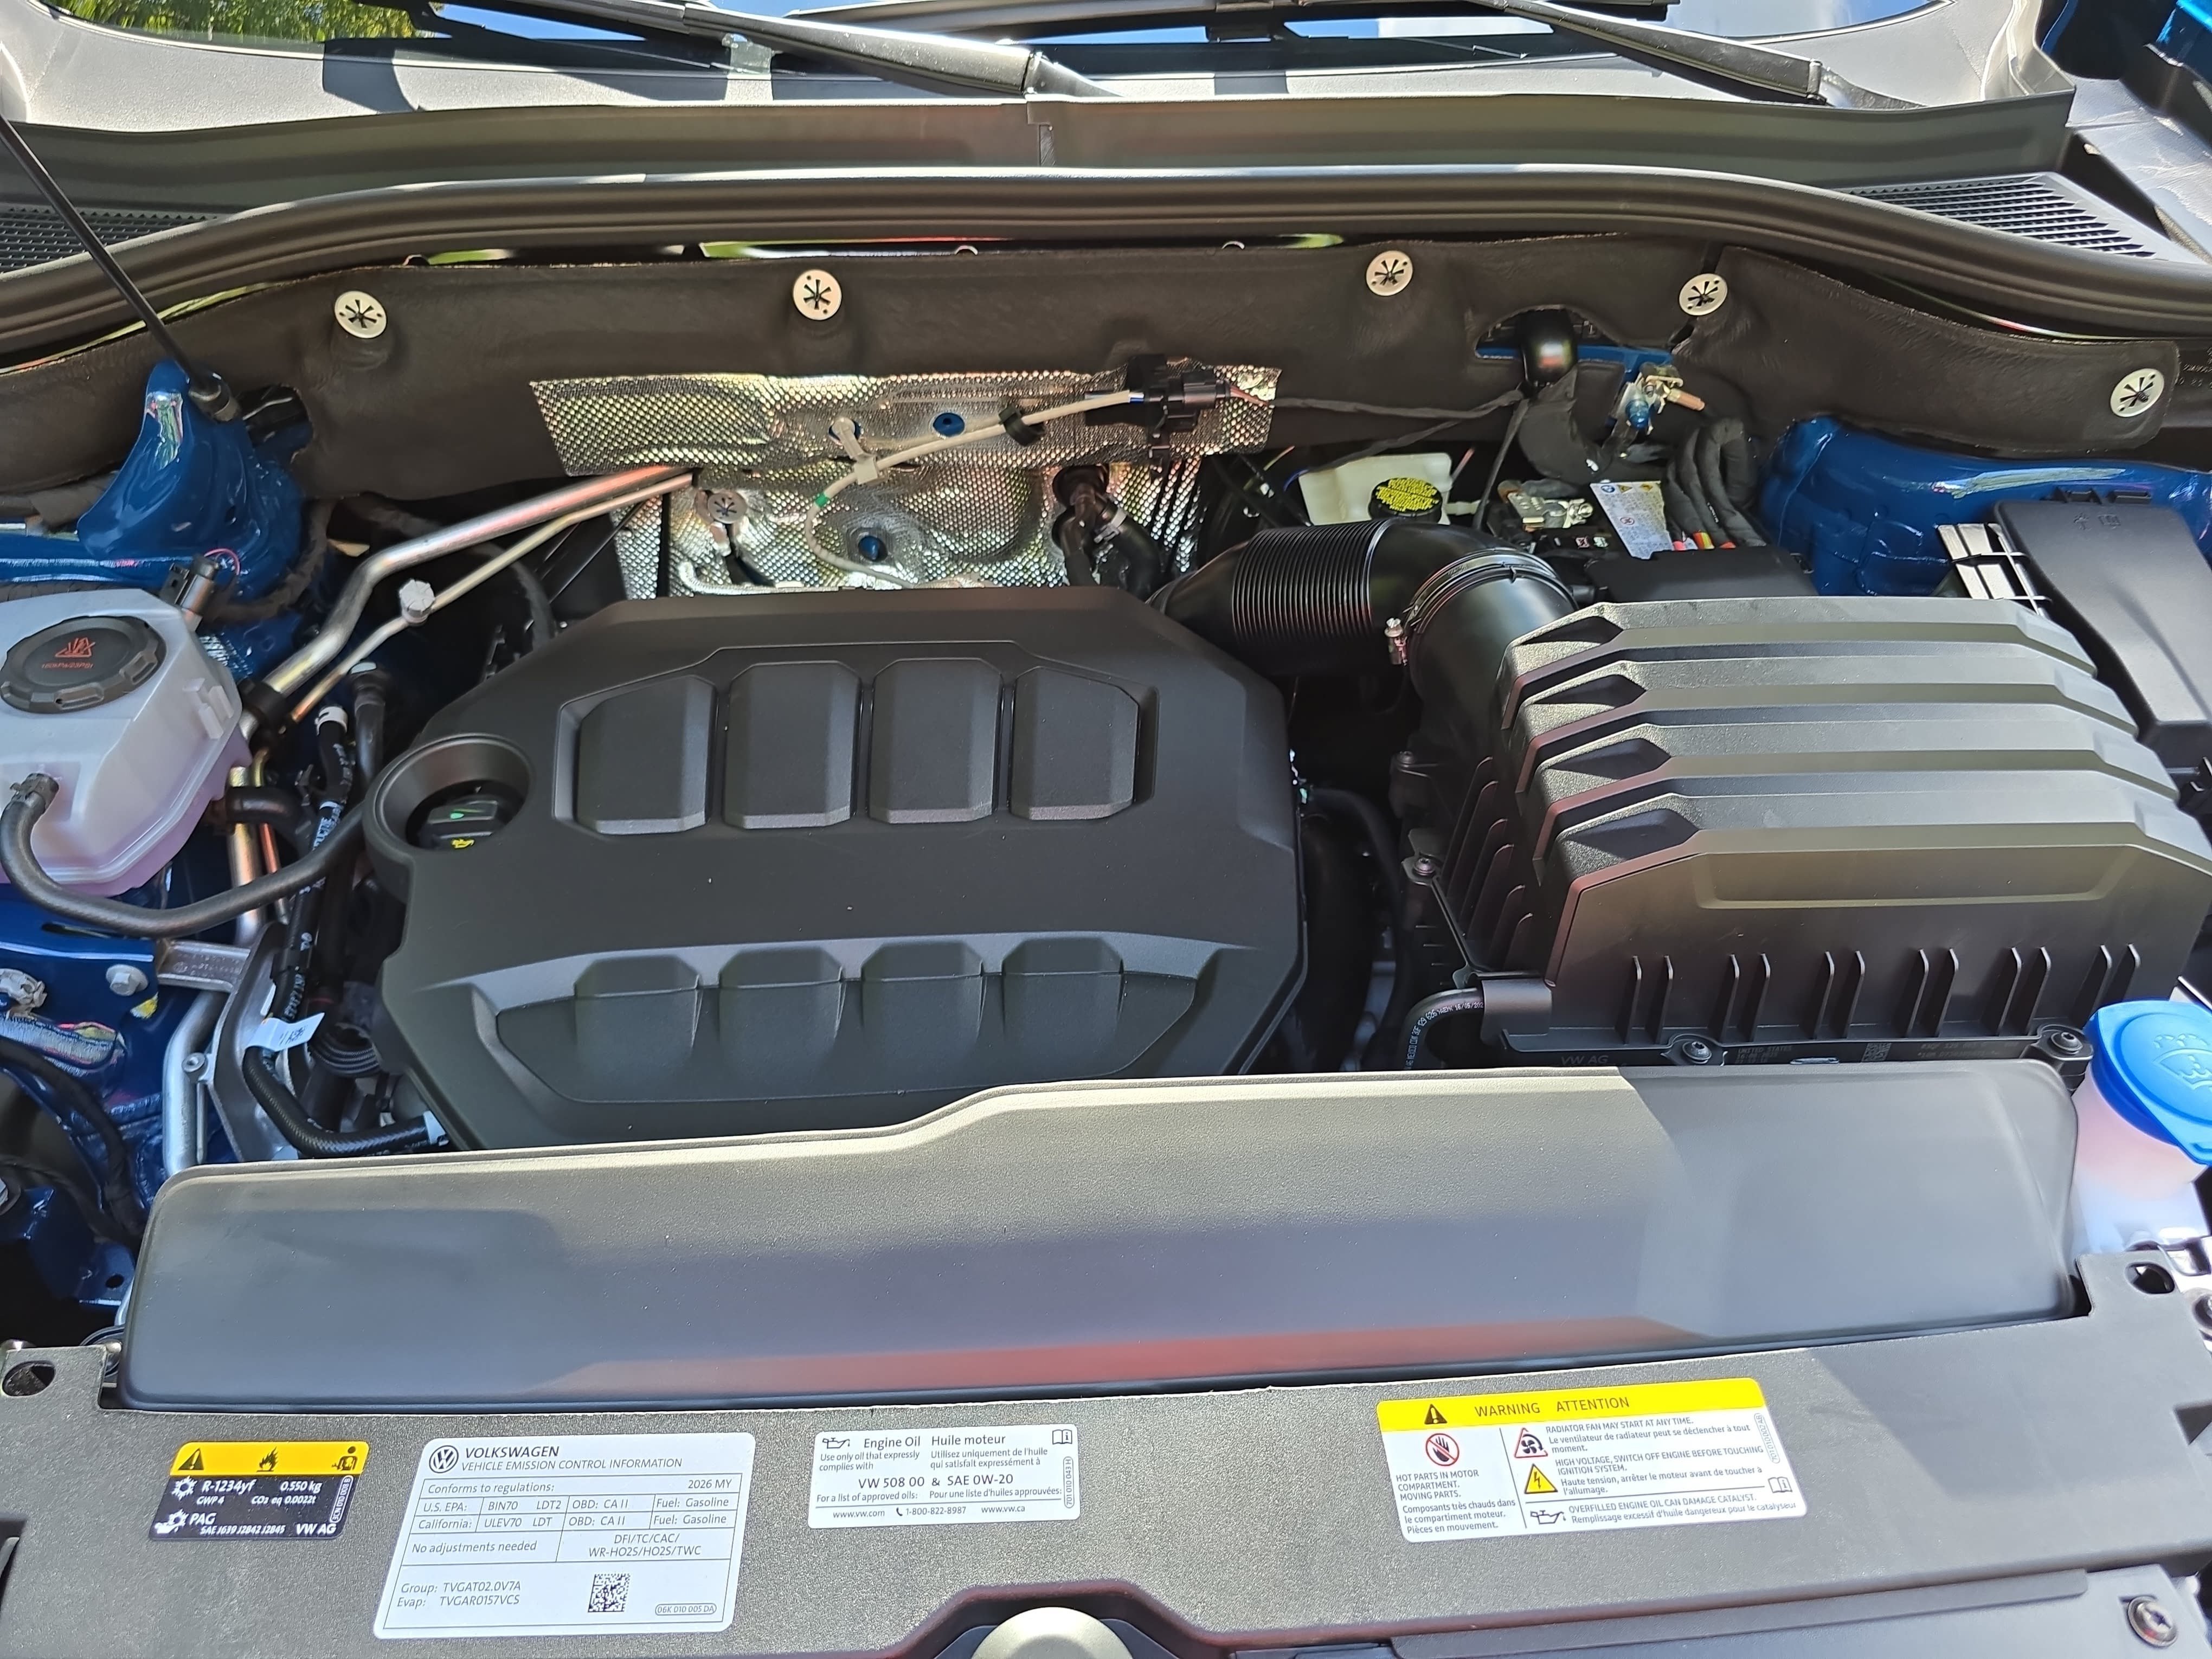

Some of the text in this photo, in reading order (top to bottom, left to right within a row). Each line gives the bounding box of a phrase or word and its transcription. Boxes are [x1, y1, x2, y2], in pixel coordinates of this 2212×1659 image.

[1561, 1055, 1609, 1065] VW AG
[1475, 1397, 1630, 1417] WARNING ATTENTION
[1546, 1424, 1584, 1433] RADIATOR
[1586, 1423, 1601, 1431] FAN
[1621, 1420, 1643, 1428] START
[931, 1435, 1006, 1446] Huile moteur
[1560, 1433, 1602, 1443] ventilateur
[1616, 1429, 1651, 1439] radiateur
[1654, 1428, 1671, 1438] peut
[1683, 1426, 1725, 1435] déclencher
[864, 1436, 921, 1450] Engine Oil
[465, 1446, 560, 1458] VOLKSWAGEN
[931, 1450, 960, 1458] Utilisez
[962, 1449, 1009, 1459] uniquement
[1552, 1445, 1587, 1454] moment.
[837, 1452, 853, 1462] only
[855, 1452, 864, 1460] oil
[884, 1450, 920, 1461] expressly
[1555, 1458, 1575, 1467] HIGH
[1576, 1456, 1612, 1464] VOLTAGE,
[1613, 1454, 1643, 1462] SWITCH
[1662, 1450, 1690, 1459] ENGINE
[1724, 1445, 1763, 1454] TOUCHING
[462, 1458, 682, 1471] VEHICLE EMISSION CONTROL INFORMATION
[819, 1463, 853, 1473] complies
[930, 1458, 1034, 1470] qui satisfait expressément
[1558, 1464, 1627, 1475] IGNITION SYSTEM.
[1414, 1472, 1438, 1481] PARTS
[1450, 1469, 1479, 1479] MOTOR
[1561, 1477, 1585, 1486] Haute
[1587, 1476, 1619, 1484] tension,
[1621, 1474, 1647, 1482] arrêter
[1658, 1470, 1687, 1480] moteur
[1690, 1469, 1712, 1477] avant
[1725, 1466, 1755, 1475] toucher
[202, 1479, 257, 1495] R-1234yf
[308, 1481, 323, 1494] kg
[689, 1479, 732, 1489] 2026 MY
[858, 1474, 1013, 1489] VW 508 00 & SAE 0W-20
[1398, 1480, 1460, 1491] COMPARTMENT.
[428, 1482, 554, 1494] Conforms to regulations:
[930, 1490, 948, 1499] Pour
[1015, 1487, 1062, 1497] approuvées:
[197, 1496, 217, 1505] GWP
[852, 1493, 861, 1501] of
[862, 1492, 899, 1503] approved
[1400, 1490, 1461, 1501] MOVING PARTS.
[423, 1502, 467, 1512] U.S. EPA:
[488, 1501, 518, 1510] BIN70
[537, 1501, 561, 1509] LDT2
[573, 1499, 618, 1509] OBD: CA
[657, 1497, 729, 1508] Fuel: Gasoline
[1403, 1499, 1515, 1514] Composants très chauds dans
[1569, 1503, 1617, 1513] OVERFILLED
[1618, 1501, 1648, 1510] ENGINE
[1682, 1496, 1716, 1506] DAMAGE
[1718, 1494, 1757, 1503] CATALYST.
[906, 1507, 966, 1516] 1-800-822-8987
[1405, 1510, 1506, 1524] le compartiment moteur.
[1571, 1514, 1622, 1524] Remplissage
[1623, 1510, 1654, 1520] excessif
[1685, 1506, 1726, 1516] dangereux
[1757, 1503, 1796, 1512] catalyseur
[189, 1513, 217, 1526] PAG
[419, 1519, 472, 1529] California:
[485, 1518, 522, 1527] ULEV70
[533, 1517, 552, 1526] LDT
[569, 1516, 615, 1526] OBD: CA
[654, 1514, 727, 1525] Fuel: Gasoline
[296, 1523, 336, 1535] VW AG
[1407, 1524, 1432, 1534] Pièces
[1446, 1521, 1499, 1532] mouvement.
[614, 1533, 680, 1544] DFI/TC/CAC/
[412, 1541, 537, 1555] No adjustments needed
[589, 1546, 701, 1558] WR-HO2S/HO2S/TWC
[401, 1584, 438, 1596] Group:
[397, 1597, 426, 1609] Evap:
